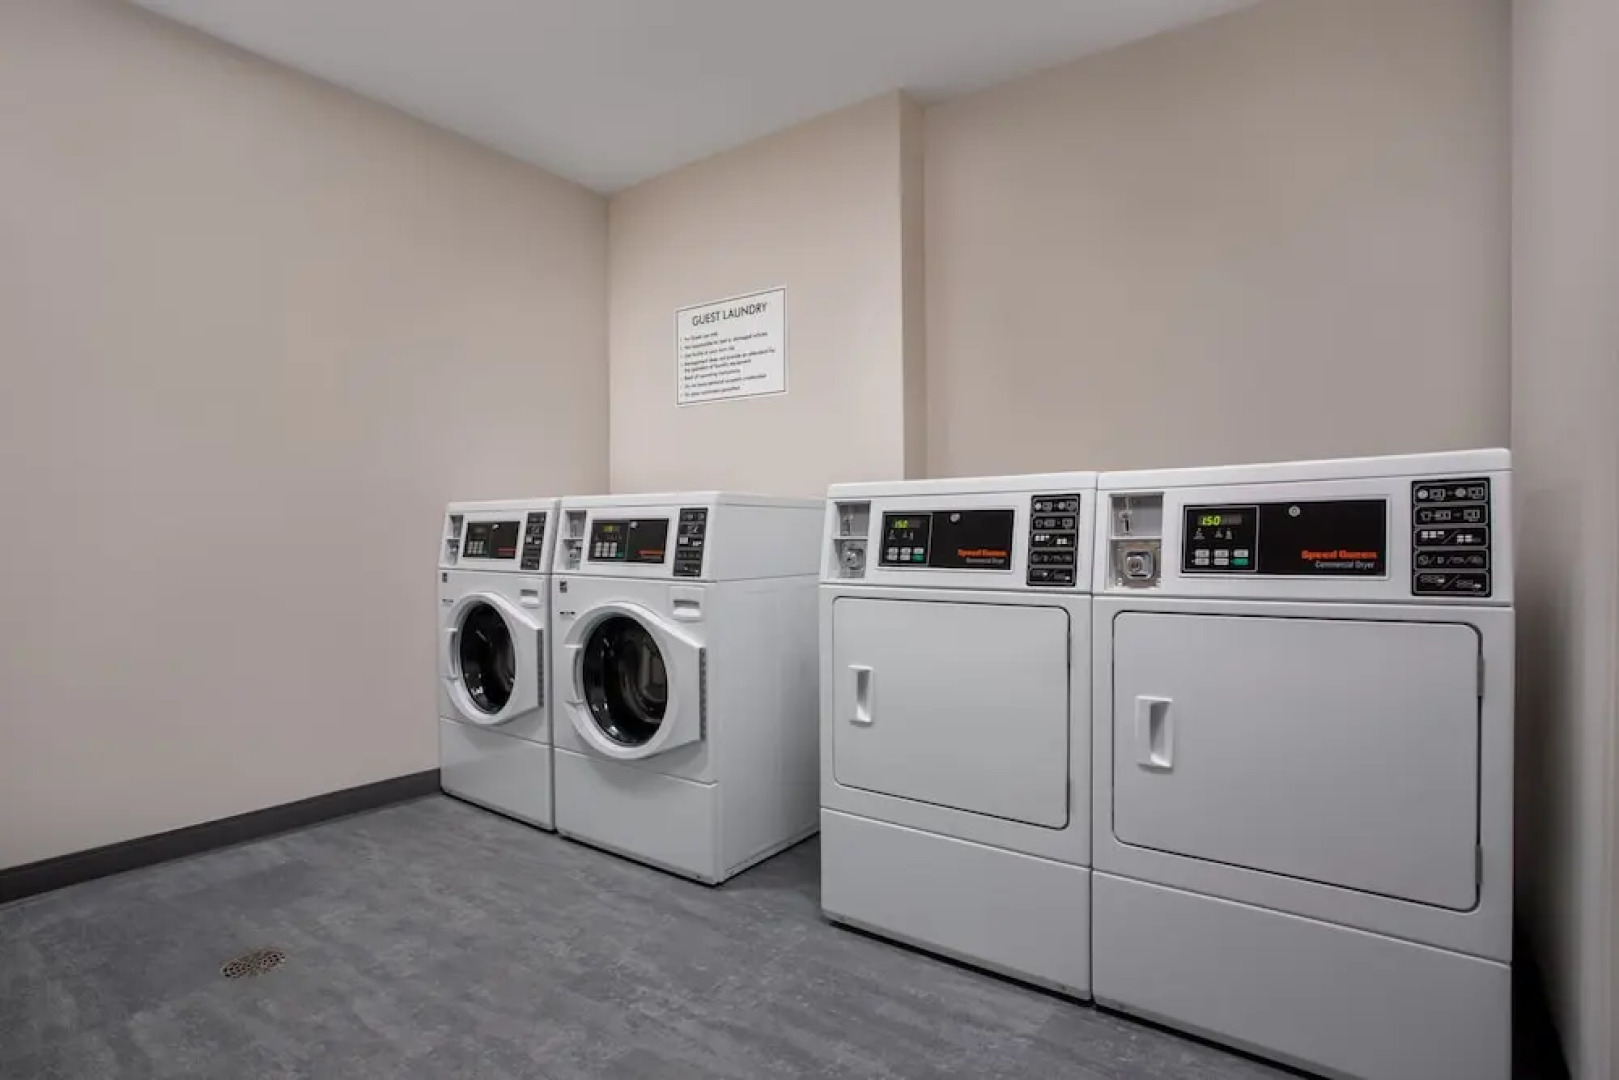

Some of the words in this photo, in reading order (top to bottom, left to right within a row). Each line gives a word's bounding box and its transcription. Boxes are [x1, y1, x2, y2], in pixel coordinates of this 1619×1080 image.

[692, 310, 720, 327] GUEST
[722, 302, 767, 320] LAUNDRY
[1301, 550, 1338, 560] Speed
[1339, 550, 1377, 560] Queen
[1315, 560, 1354, 569] Commercial
[1355, 560, 1374, 571] Dryer
